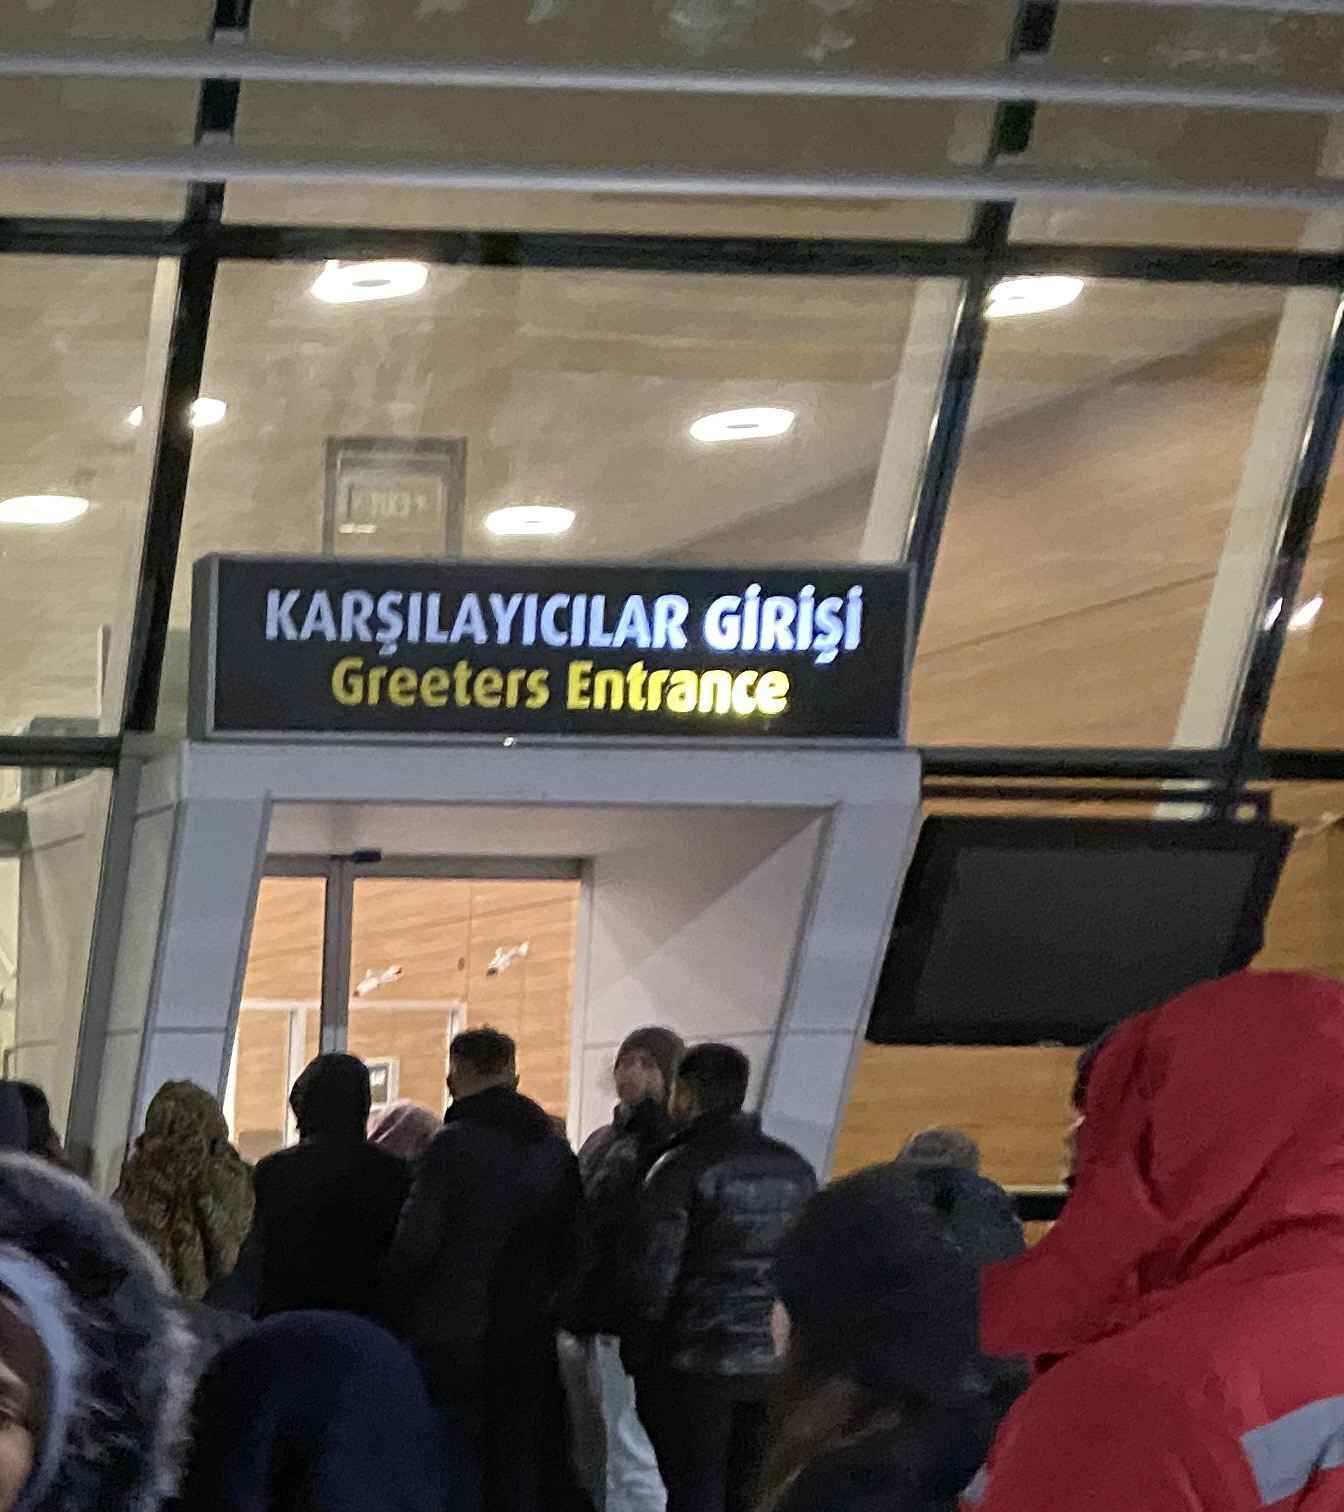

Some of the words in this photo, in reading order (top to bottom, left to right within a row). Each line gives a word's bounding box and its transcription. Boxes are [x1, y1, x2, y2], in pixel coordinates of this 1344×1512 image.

[265, 588, 690, 656] KARŞILAYICILAR
[703, 583, 863, 664] GİRİŞİ
[331, 655, 550, 709] Greeters
[567, 660, 791, 715] Entrance
